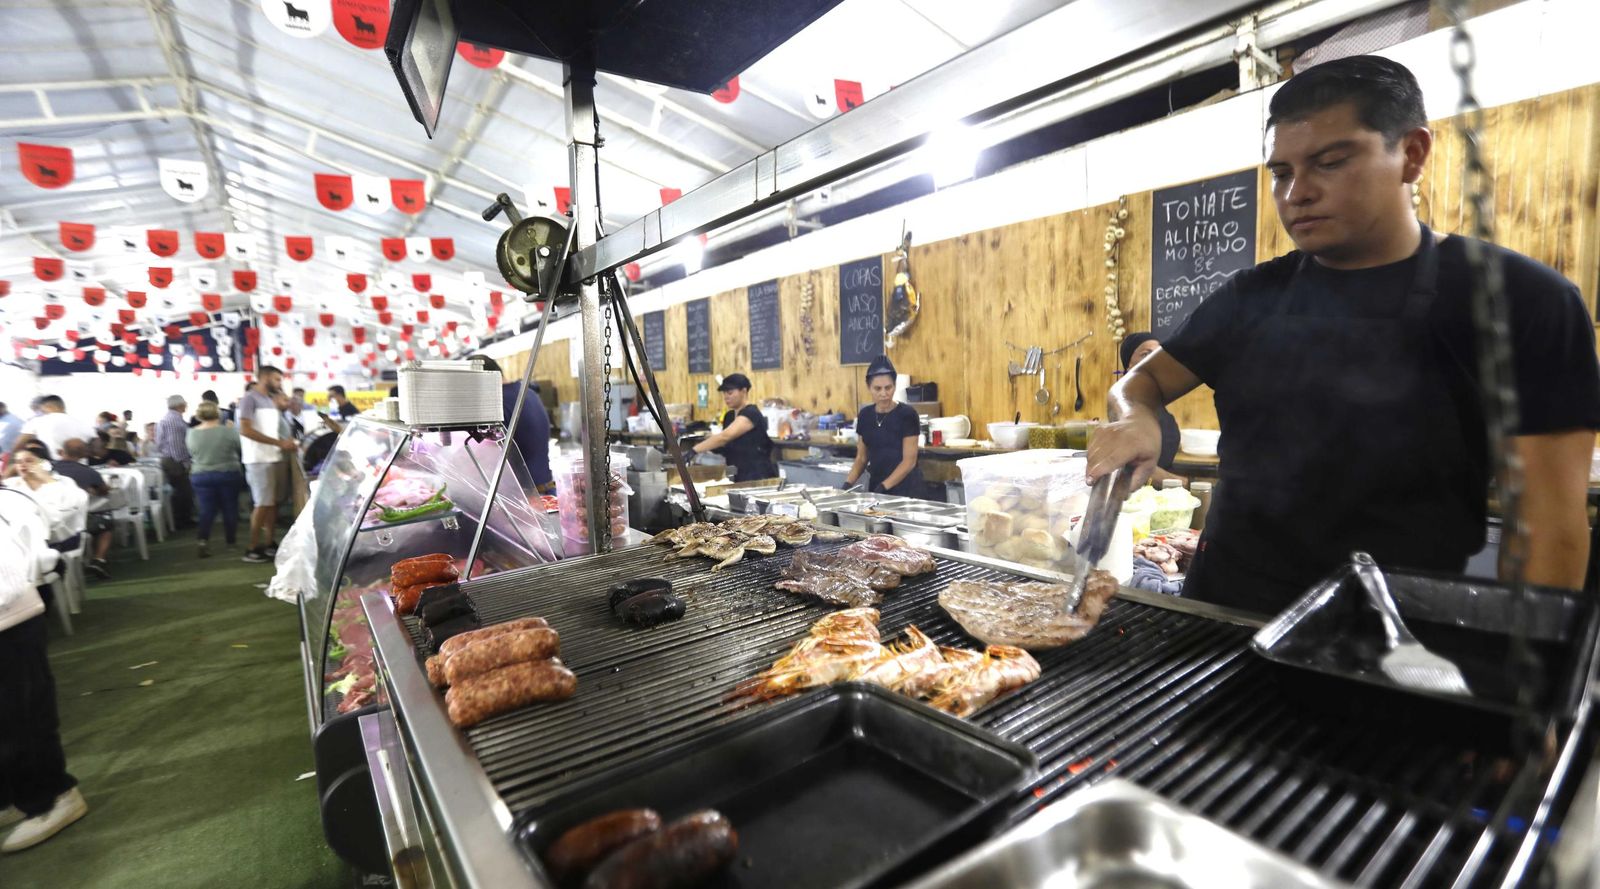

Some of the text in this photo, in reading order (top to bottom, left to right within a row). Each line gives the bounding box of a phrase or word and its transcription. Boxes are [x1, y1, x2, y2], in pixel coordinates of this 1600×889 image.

[1162, 186, 1248, 223] TOMATE
[1165, 220, 1239, 247] ALIÑAO
[844, 266, 881, 289] COPAS
[1156, 281, 1223, 300] BERENJE
[848, 293, 877, 313] VASO
[1157, 300, 1183, 314] CON
[848, 314, 880, 331] ANCHO
[1157, 315, 1173, 327] DE
